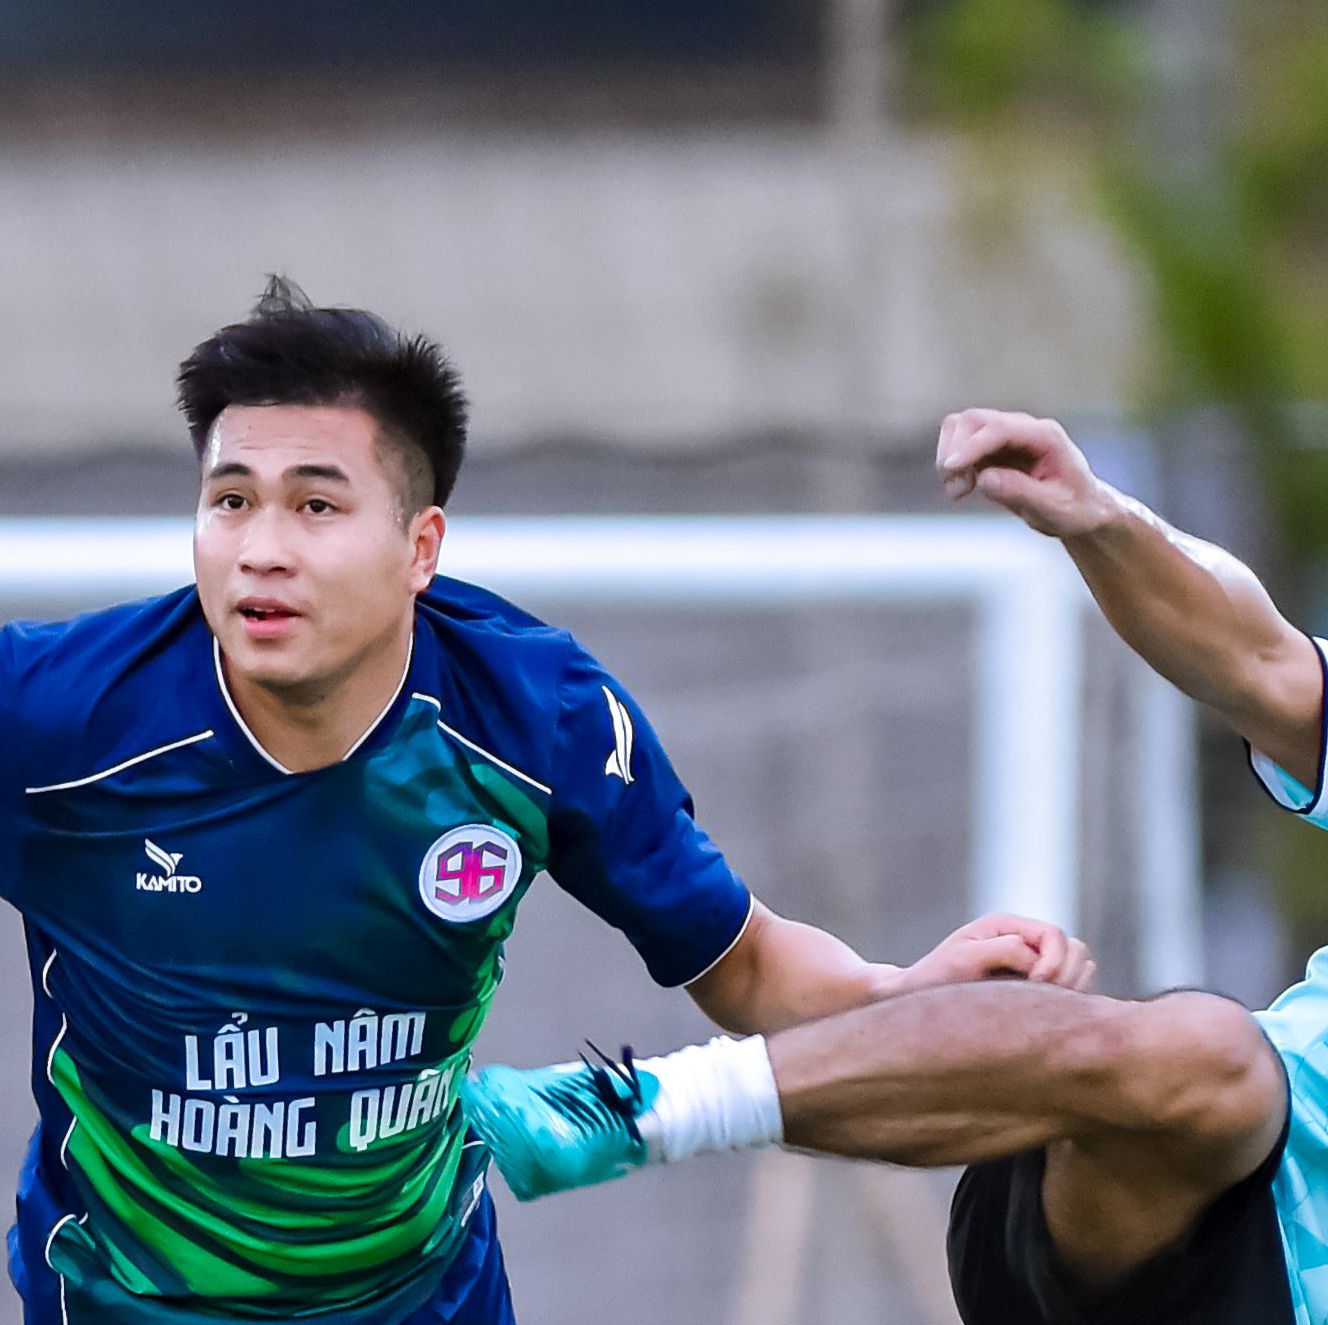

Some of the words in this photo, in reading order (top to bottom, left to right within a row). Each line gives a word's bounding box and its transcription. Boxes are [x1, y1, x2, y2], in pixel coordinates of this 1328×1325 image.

[136, 872, 202, 893] KAMITO
[435, 840, 508, 906] 96
[185, 1012, 279, 1091] LẨU
[314, 1007, 426, 1076] NÂM
[149, 1088, 316, 1159] HOÀNG
